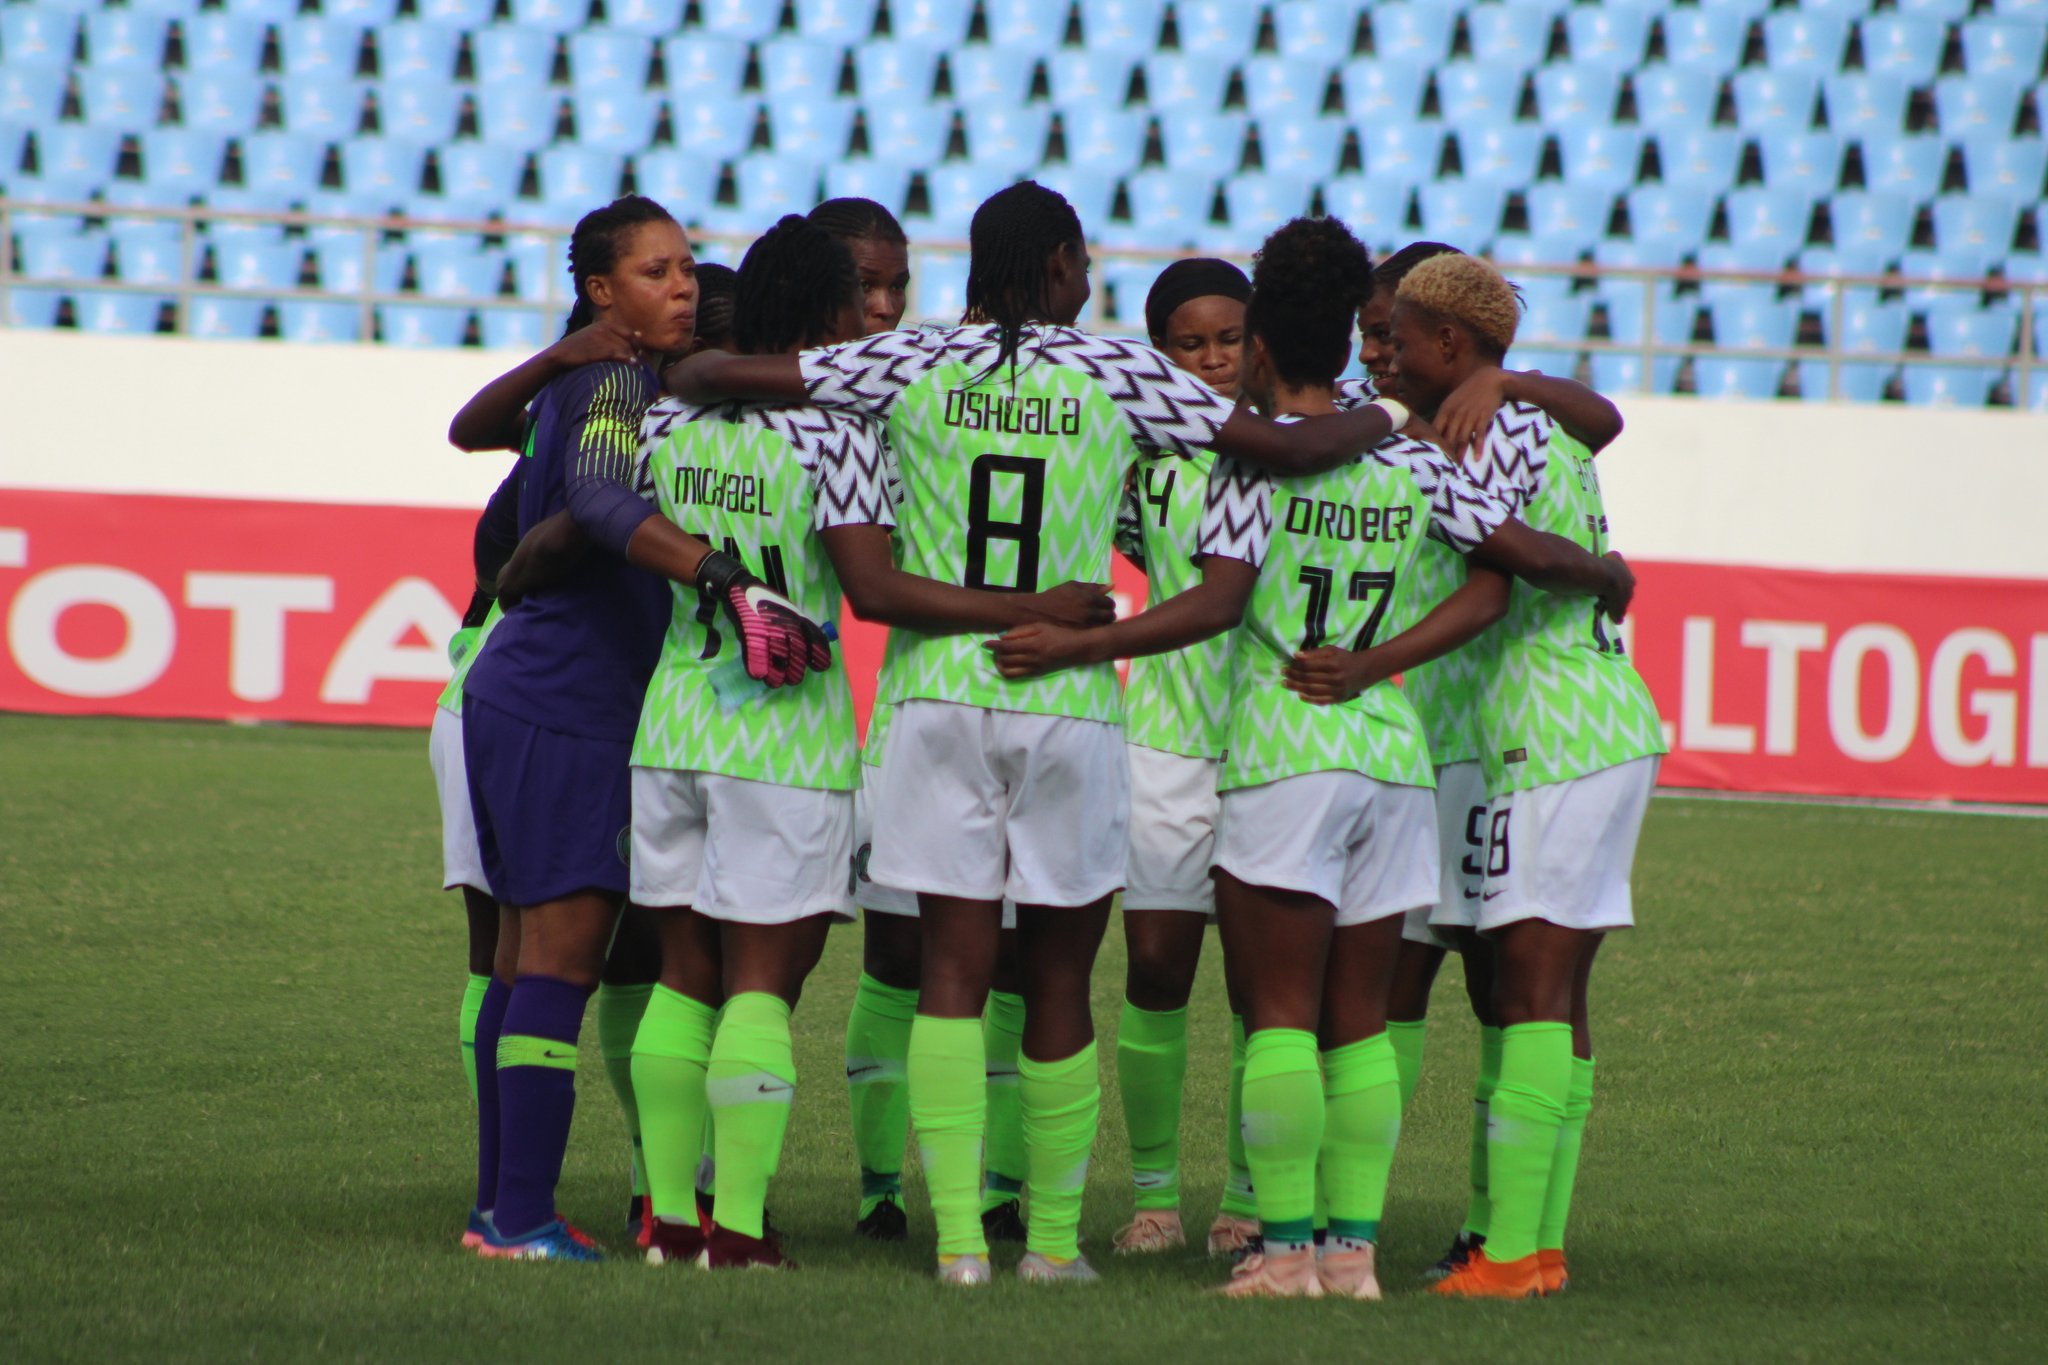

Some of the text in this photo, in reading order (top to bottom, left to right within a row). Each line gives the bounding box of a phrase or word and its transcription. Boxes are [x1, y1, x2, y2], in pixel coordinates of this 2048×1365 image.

[964, 453, 1046, 593] 8
[1144, 467, 1177, 528] 4
[0, 529, 464, 703] OTA
[1298, 565, 1396, 653] 17
